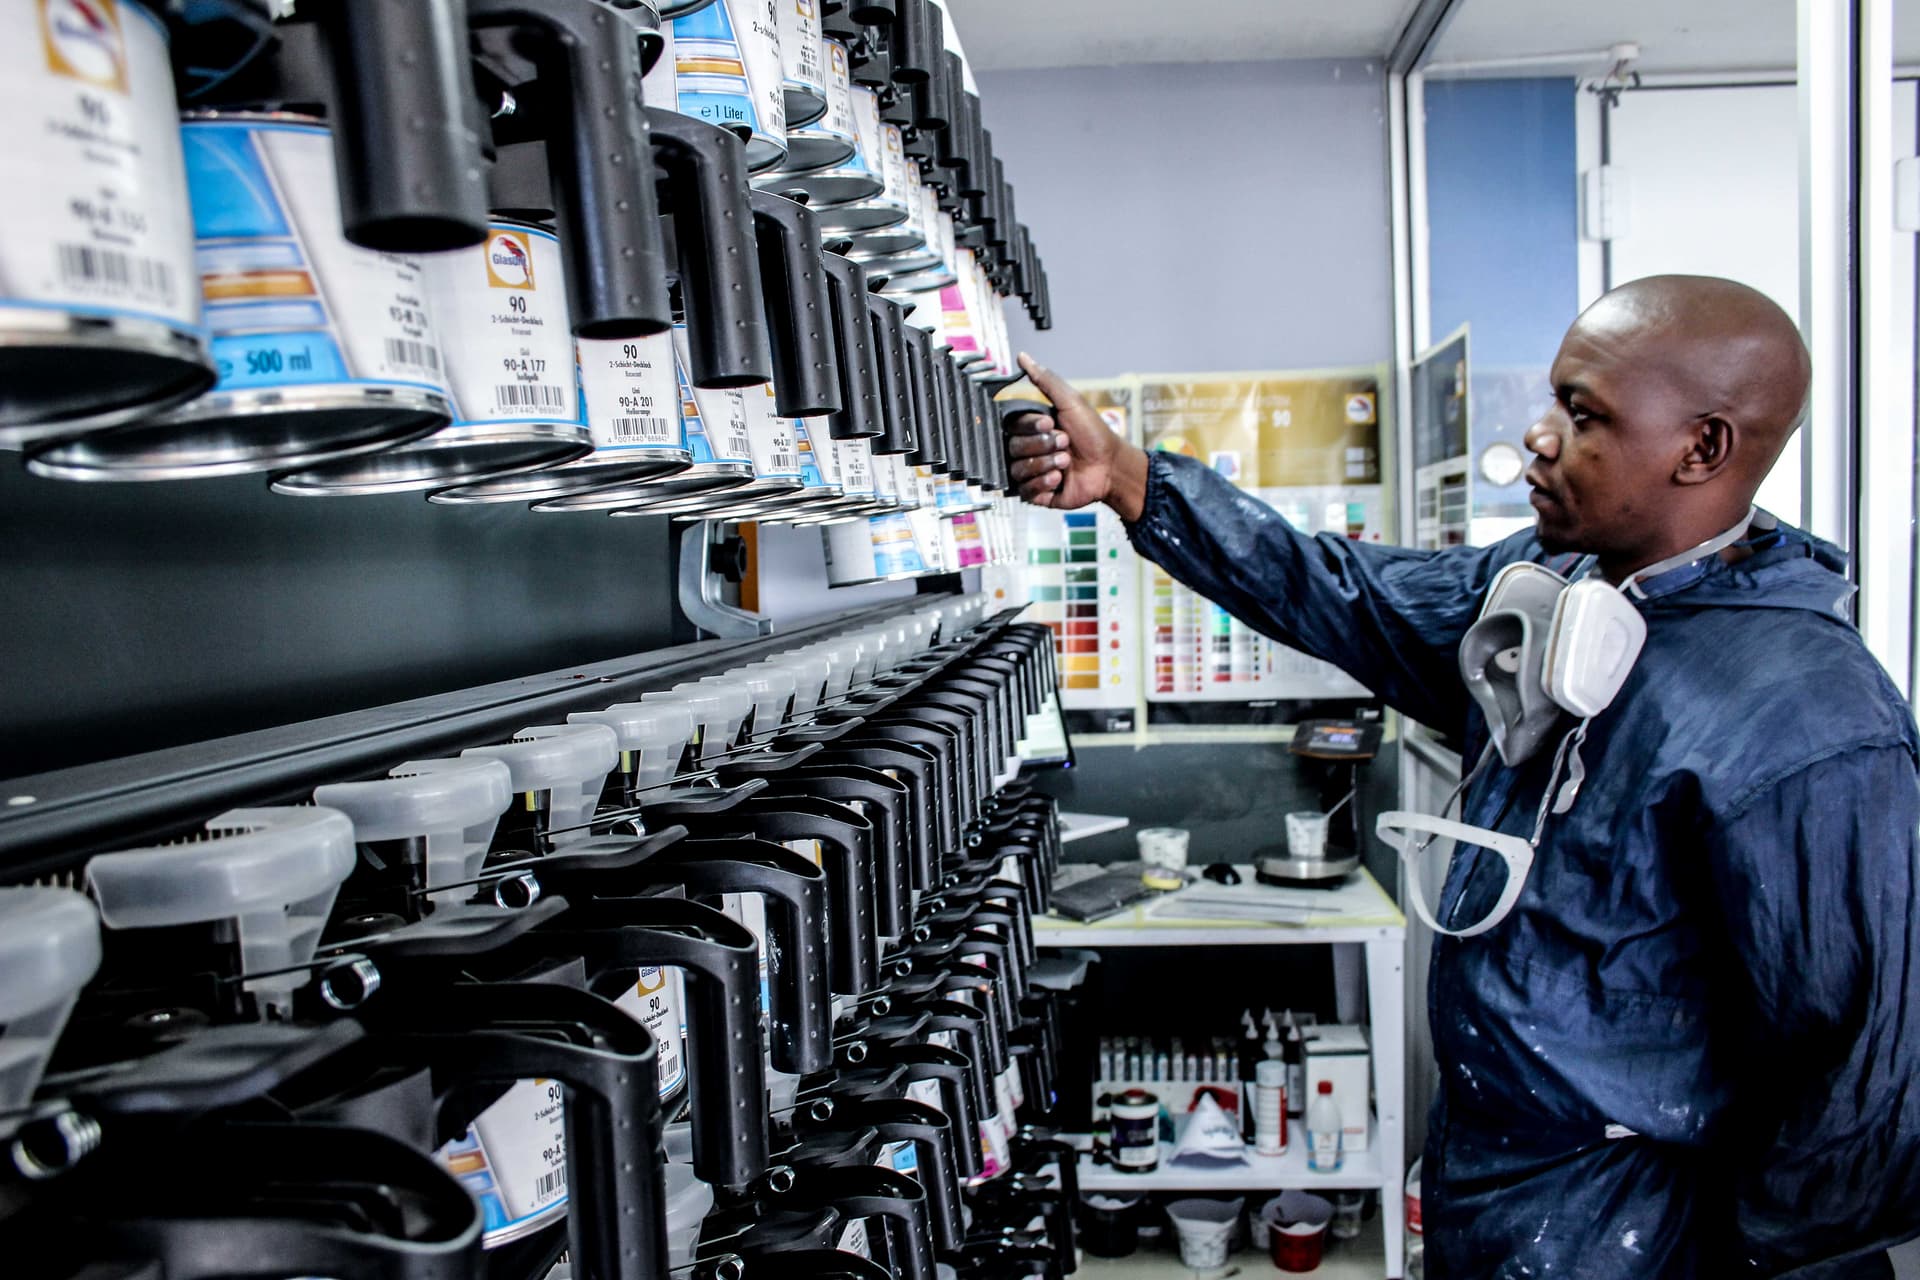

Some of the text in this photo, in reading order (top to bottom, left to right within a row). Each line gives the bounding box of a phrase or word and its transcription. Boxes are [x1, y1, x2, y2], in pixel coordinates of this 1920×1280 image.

[714, 104, 720, 119] 1
[724, 104, 744, 121] Liter
[509, 296, 526, 314] 90
[245, 344, 313, 376] 500 ml
[623, 344, 638, 359] 90
[503, 358, 546, 373] 90-A 177
[618, 396, 654, 408] 90-A 201
[649, 996, 660, 1012] 90
[548, 1084, 561, 1103] 90
[543, 1143, 561, 1161] 90-A
